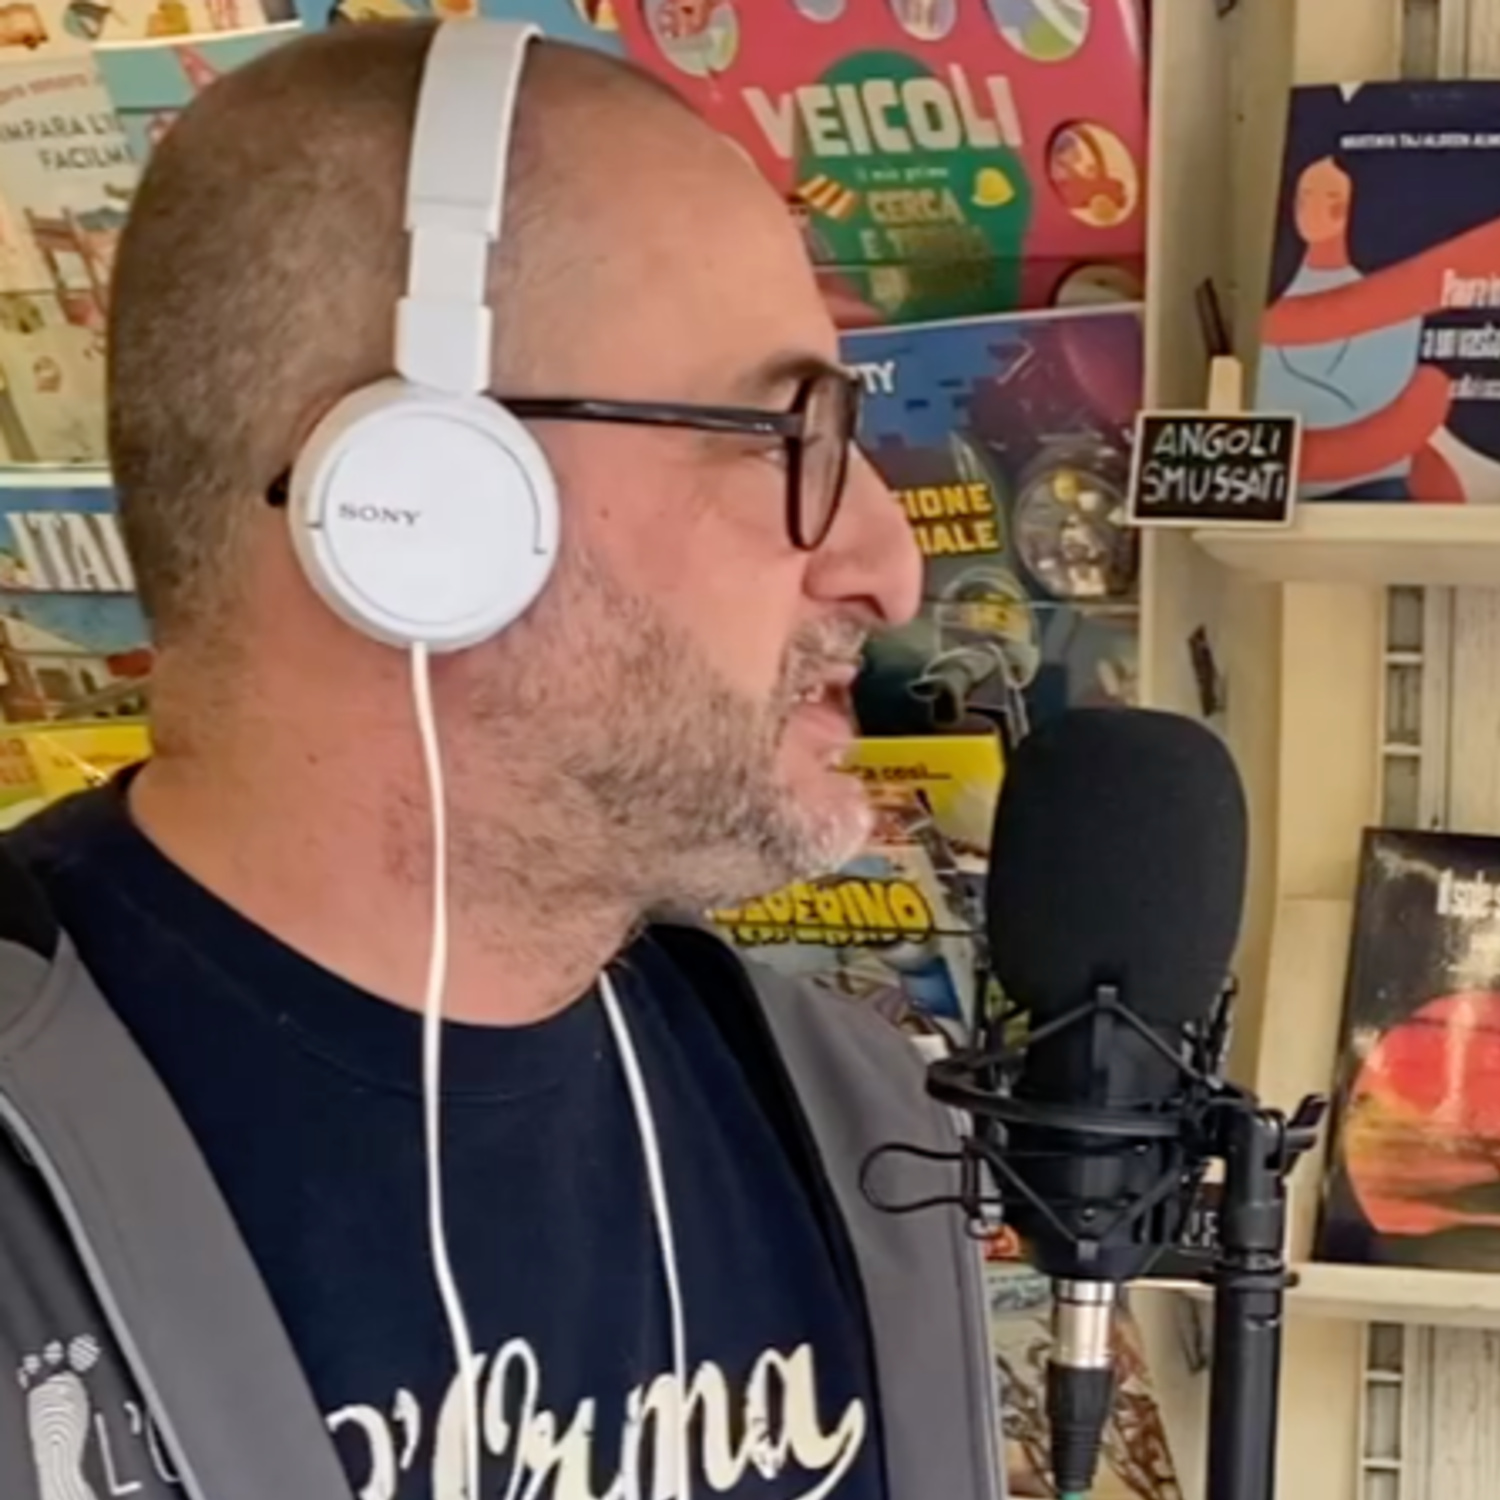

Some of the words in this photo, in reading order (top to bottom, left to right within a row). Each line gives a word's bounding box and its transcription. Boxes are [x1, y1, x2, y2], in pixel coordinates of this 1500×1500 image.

[740, 63, 1022, 158] VEICOLI
[1153, 422, 1281, 460] ANGOLI
[904, 483, 993, 518] IONE
[1141, 460, 1285, 504] SMUSSATI
[338, 502, 421, 526] SONY
[916, 520, 999, 556] IALE
